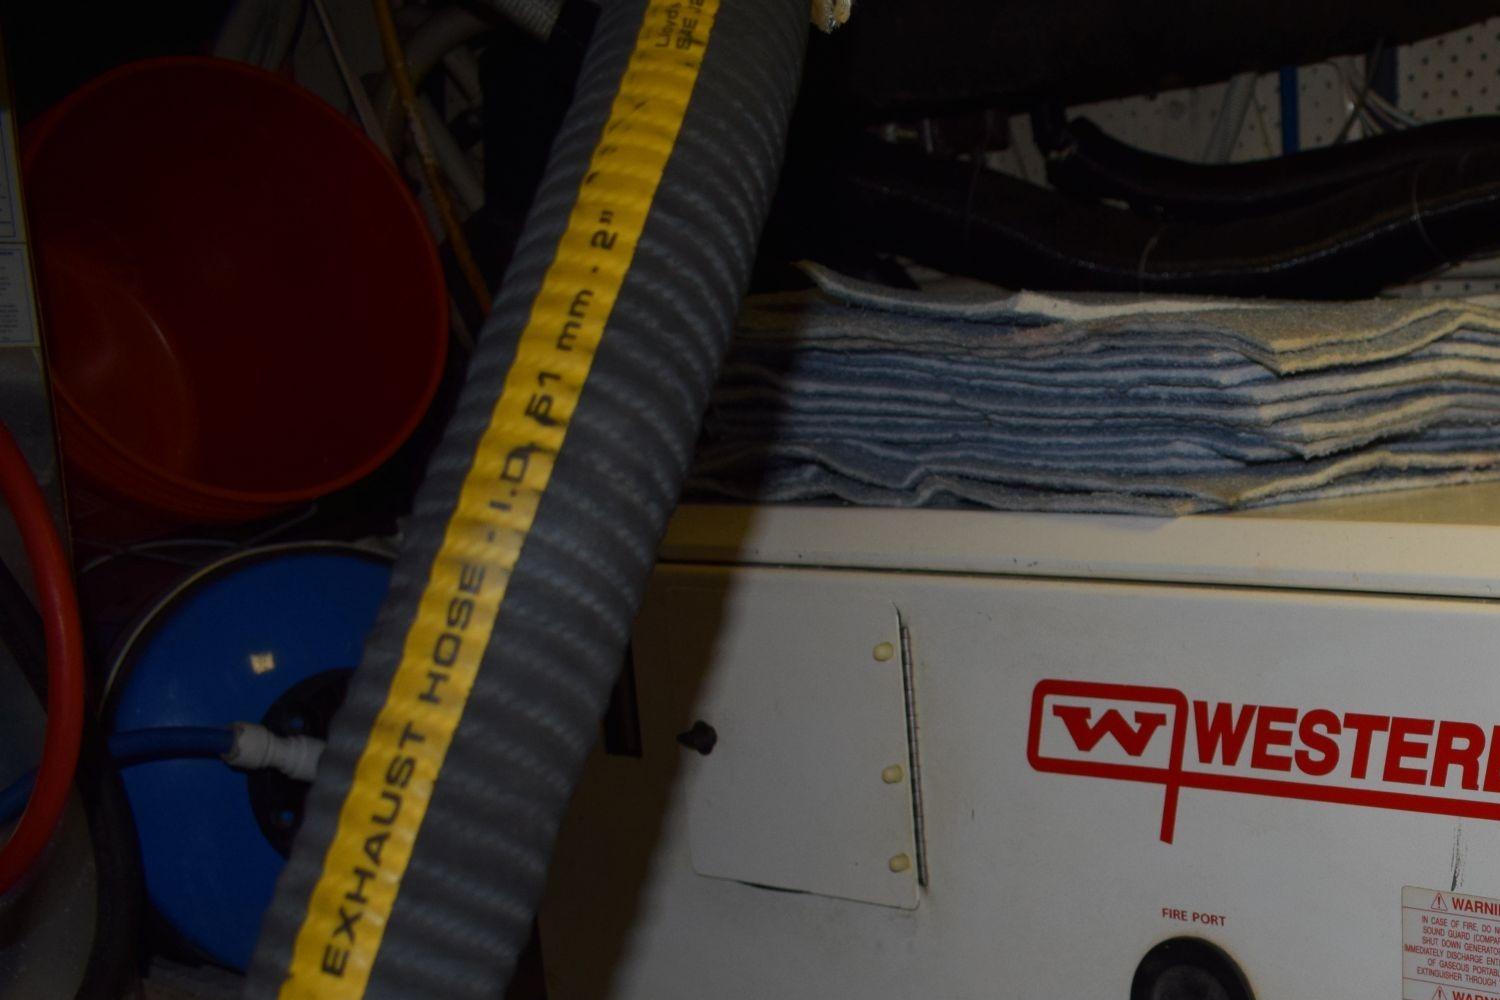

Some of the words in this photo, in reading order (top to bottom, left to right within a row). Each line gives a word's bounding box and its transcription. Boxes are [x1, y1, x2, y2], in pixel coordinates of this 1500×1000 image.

[322, 721, 428, 978] EXHAUST
[419, 562, 488, 704] HOSE
[555, 288, 596, 351] mm
[1162, 908, 1188, 921] FIRE
[1192, 912, 1226, 926] PORT
[1431, 917, 1448, 926] CASE
[1482, 925, 1491, 933] DO
[1423, 927, 1445, 936] SOUND
[1448, 930, 1470, 939] GUARD
[1422, 936, 1438, 946] SHUT
[1442, 939, 1461, 950] DOWN
[1405, 944, 1443, 958] IMMEDIATELY
[1447, 950, 1483, 964] DISCHARGE
[1428, 959, 1436, 967] OF
[1439, 960, 1469, 973] GASEOUS
[1417, 967, 1462, 982] EXTINGUISHER
[1466, 975, 1496, 987] THROUGH
